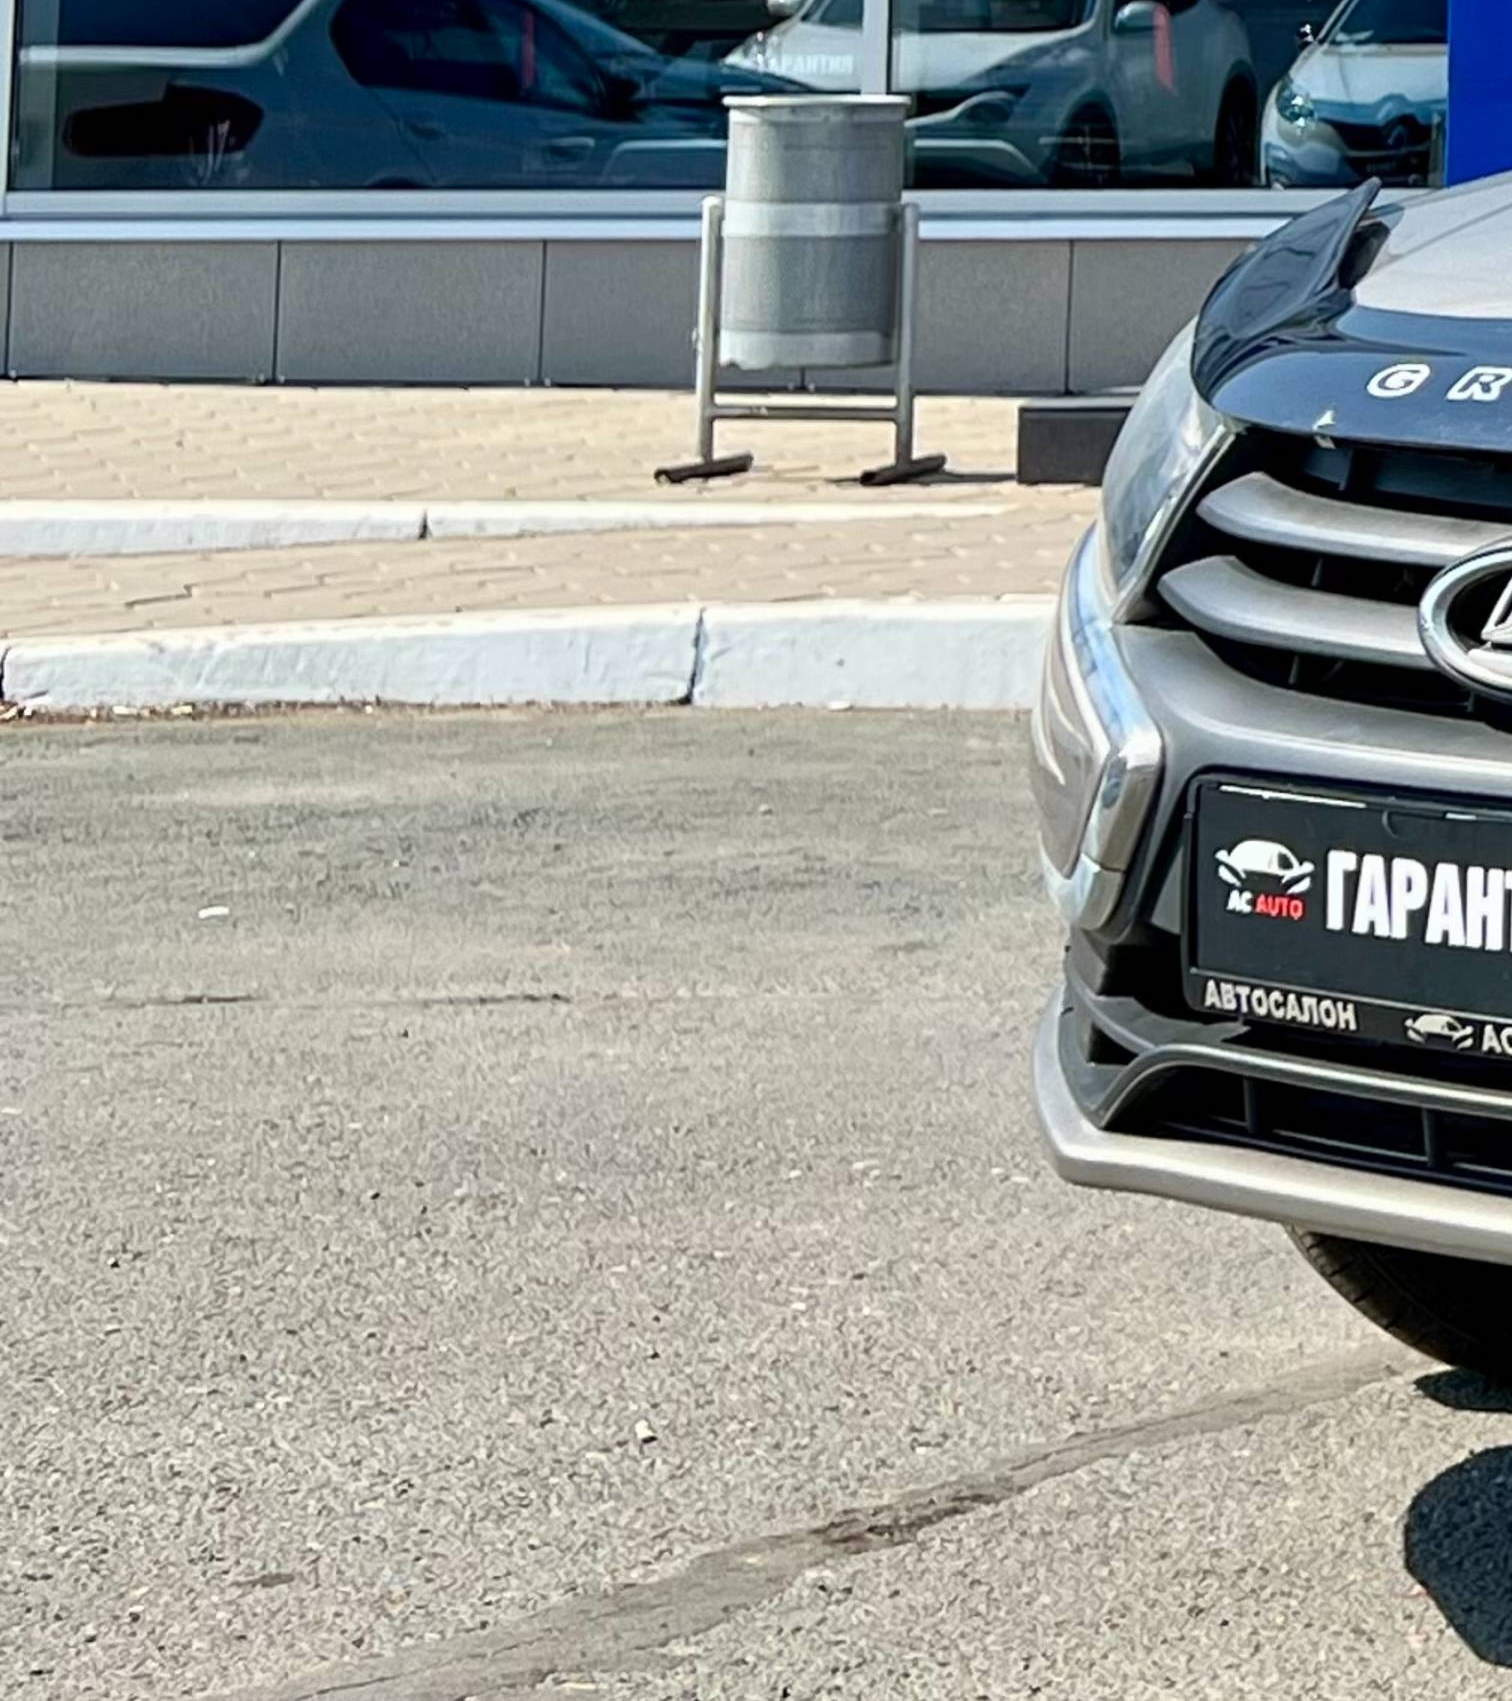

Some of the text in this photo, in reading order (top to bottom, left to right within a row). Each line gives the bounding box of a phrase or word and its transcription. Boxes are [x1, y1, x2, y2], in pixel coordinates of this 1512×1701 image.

[1226, 889, 1304, 921] AC AUTO
[1204, 978, 1358, 1032] АВТОСАЛОН
